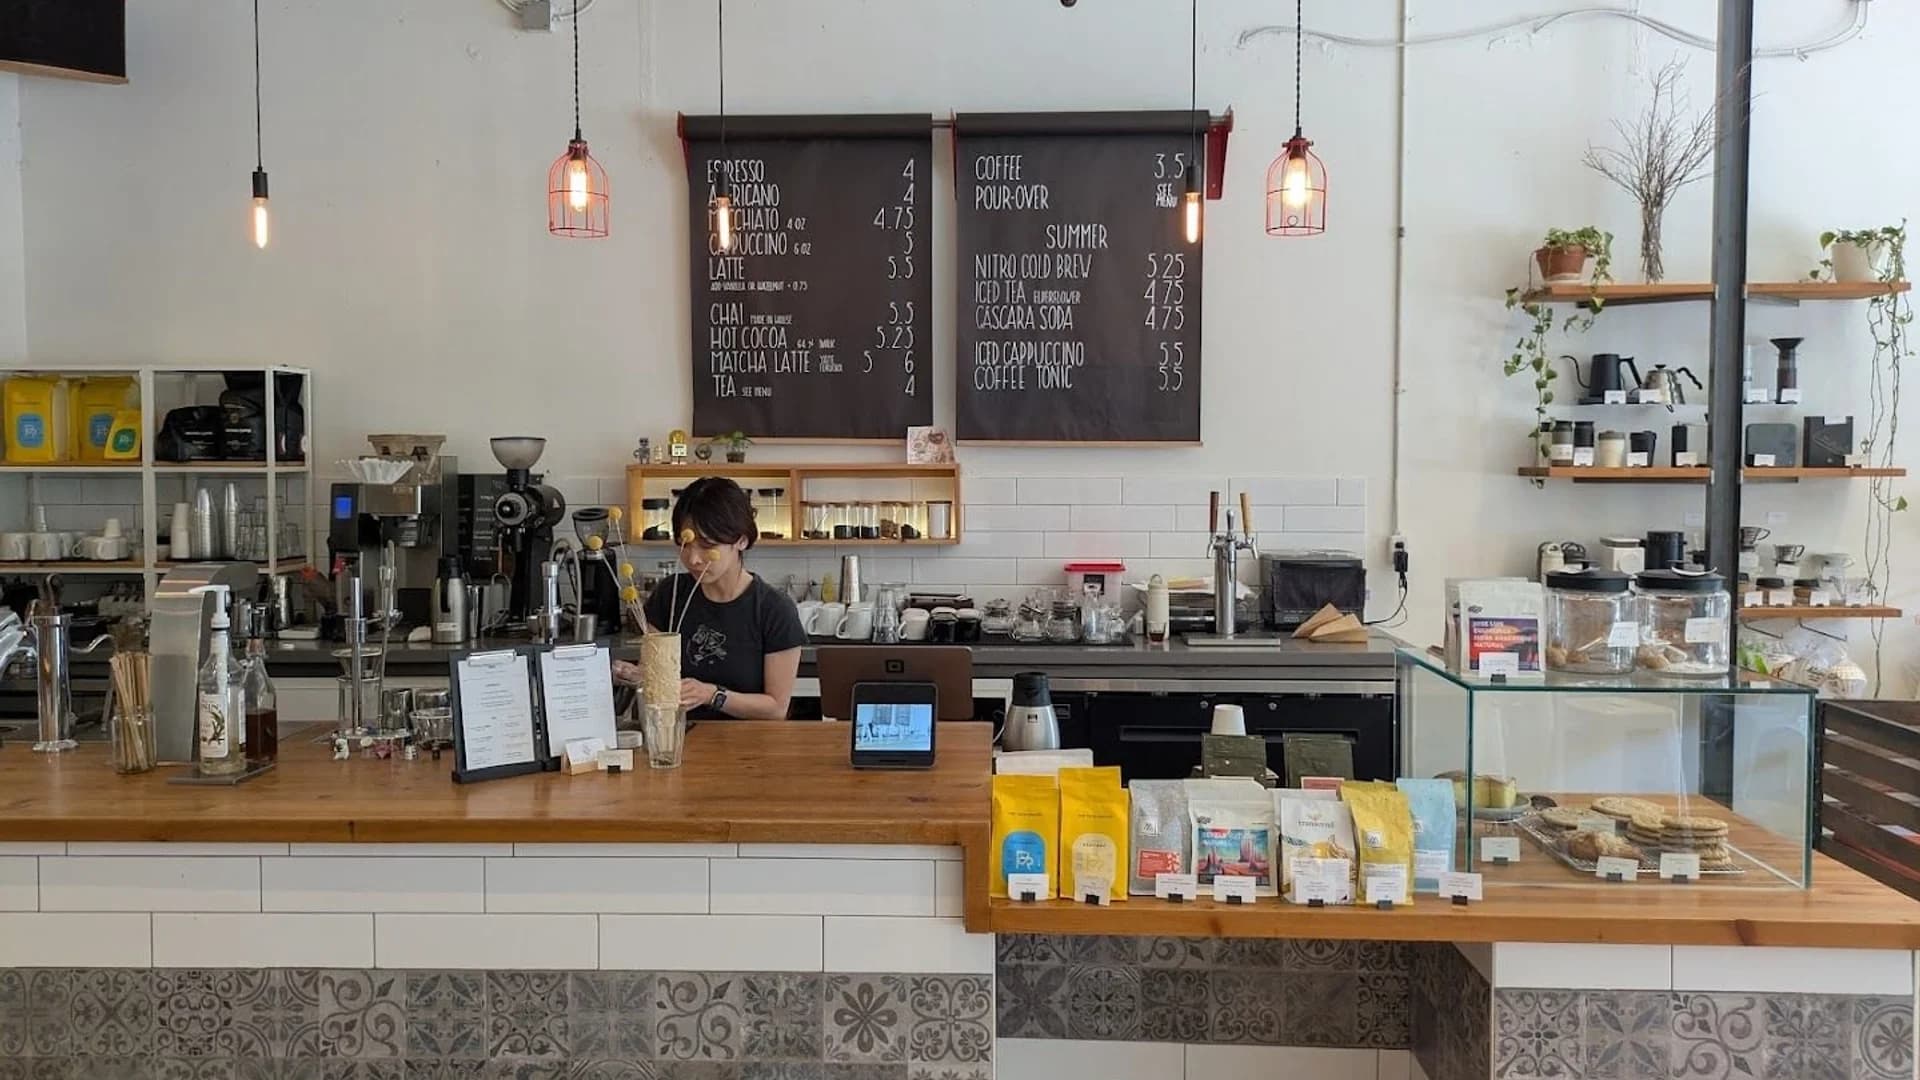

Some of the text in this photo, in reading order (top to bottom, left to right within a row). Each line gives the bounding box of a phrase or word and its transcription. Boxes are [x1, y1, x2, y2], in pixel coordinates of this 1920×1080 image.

[903, 159, 914, 181] 4
[976, 153, 1184, 180] COFFEE 3.5
[903, 183, 914, 205] 4
[976, 185, 1048, 210] POUR-OVER
[787, 218, 793, 230] 4
[873, 207, 913, 230] 4.75
[794, 242, 799, 255] 6
[904, 231, 913, 254] 5
[1046, 224, 1108, 249] SUMMER
[709, 256, 913, 280] LATTE 5.5
[976, 253, 1184, 279] NITRO COLD BREW 5.25
[976, 280, 1184, 305] ICED TEA ELDERFLOWER 4.75
[711, 302, 743, 325] CHAI
[889, 302, 913, 325] 5.5
[1040, 306, 1072, 330] SODA
[1144, 305, 1184, 331] 4.75
[711, 327, 737, 349] HOT
[741, 326, 787, 349] COCOA
[876, 326, 913, 349] 5.25
[712, 350, 913, 373] MATCHA LATTE 5 6
[976, 341, 1183, 366] ICED CAPPUCCINO 5.5
[713, 375, 736, 398] TEA
[905, 375, 914, 397] 4
[975, 366, 1182, 391] COFFEE TONIC 5.5
